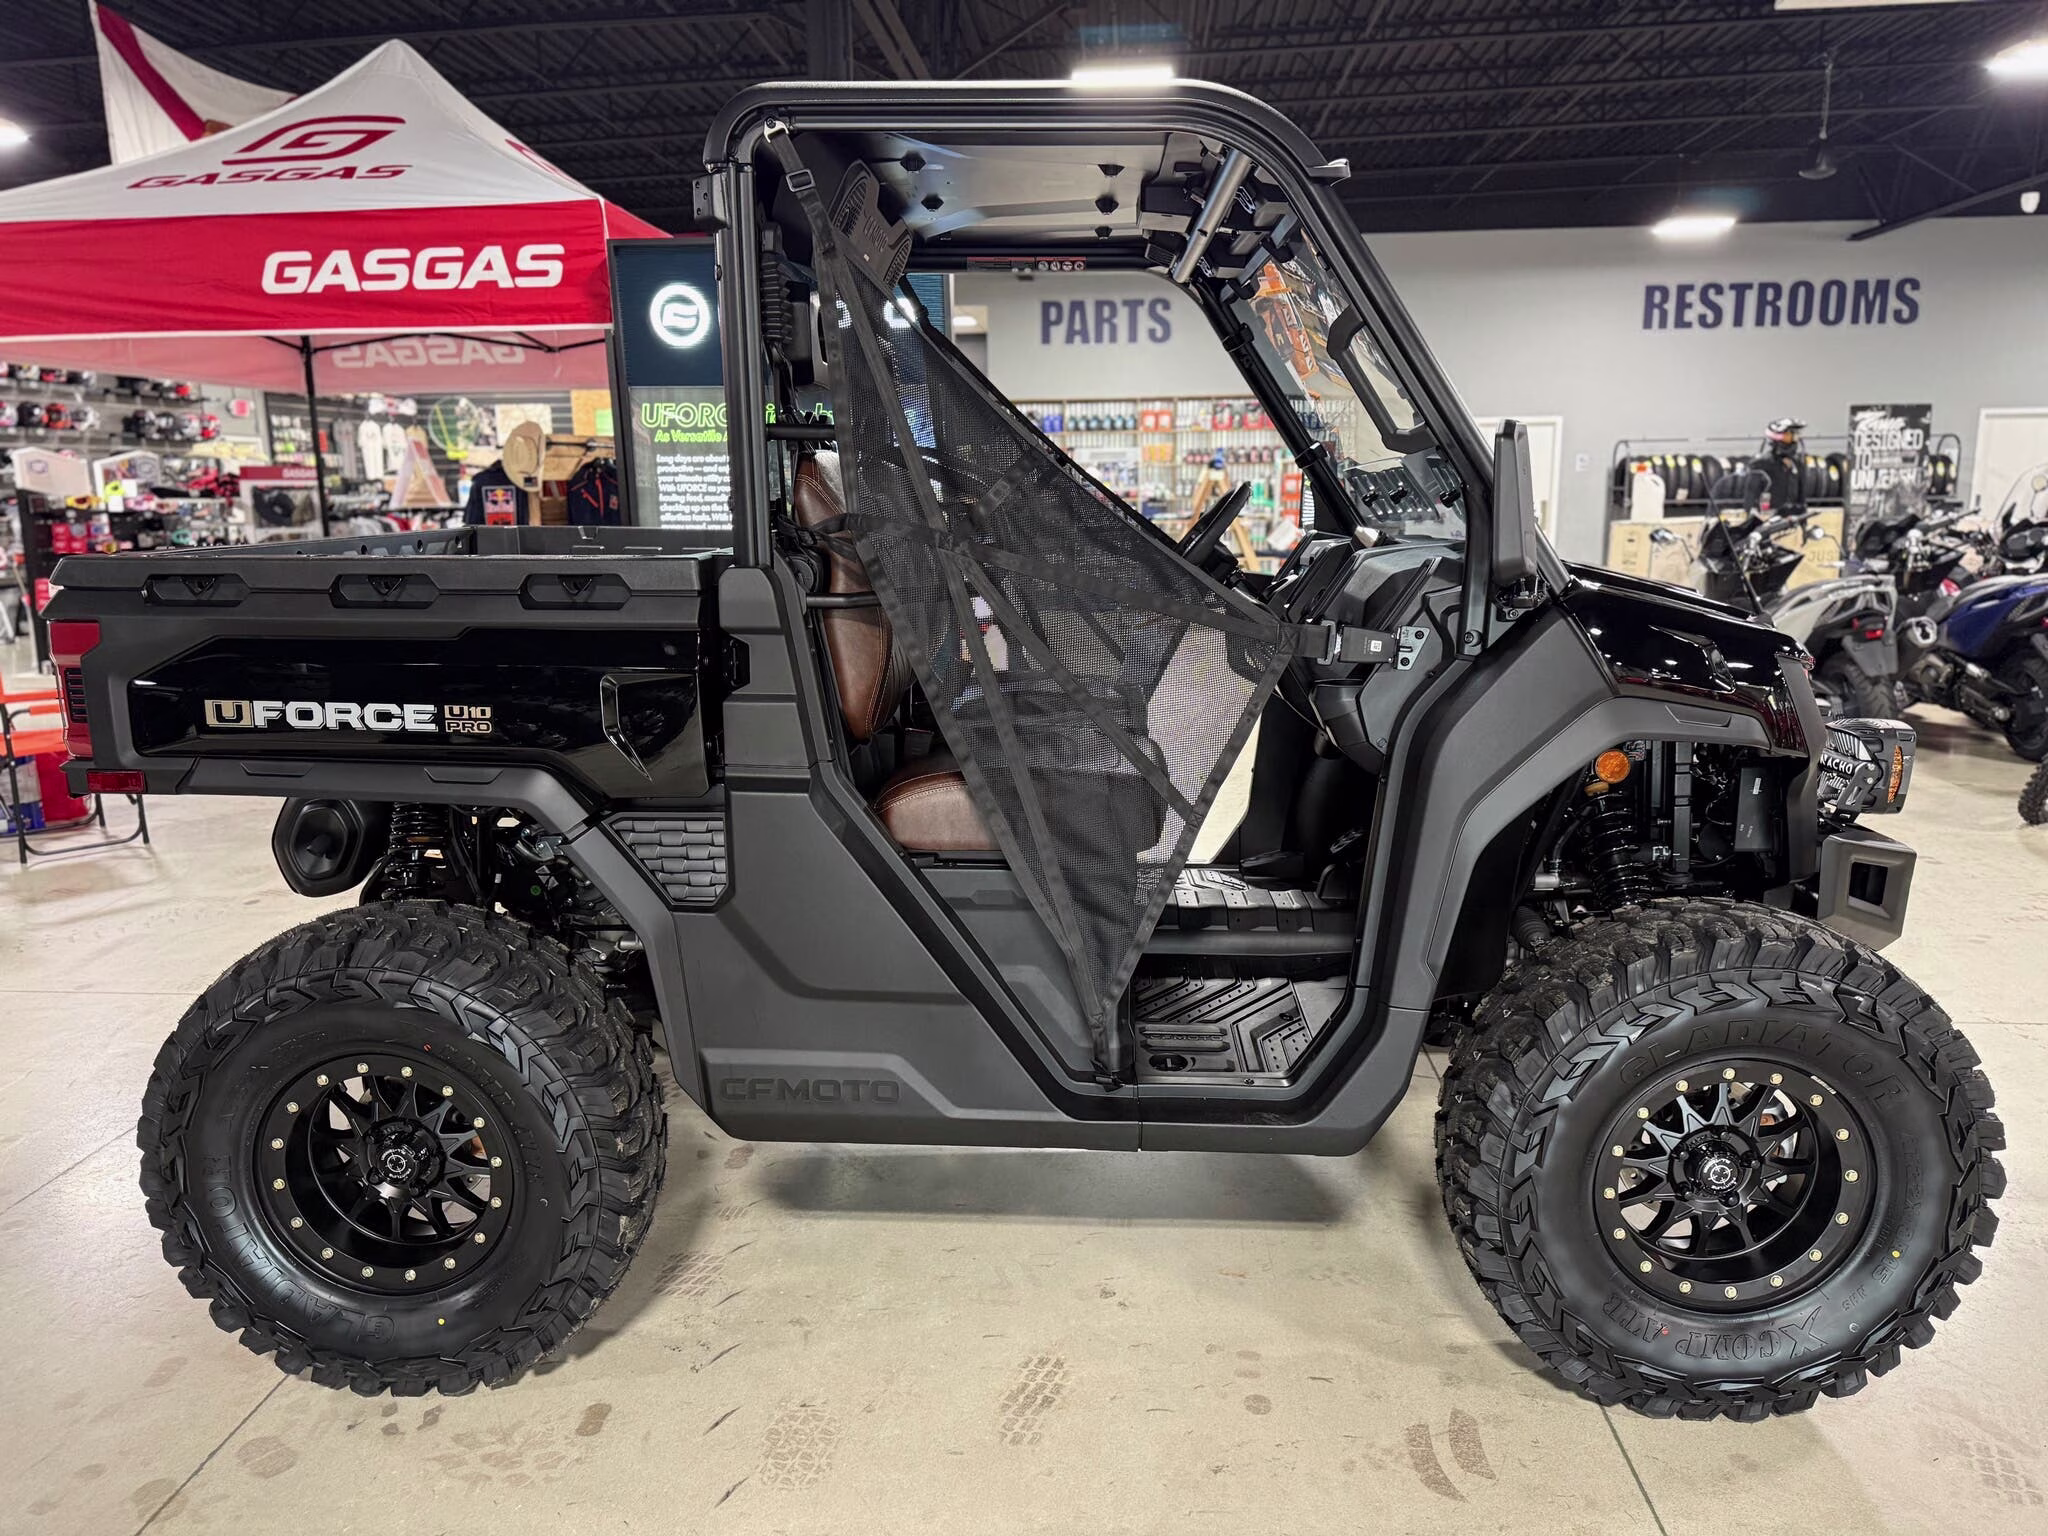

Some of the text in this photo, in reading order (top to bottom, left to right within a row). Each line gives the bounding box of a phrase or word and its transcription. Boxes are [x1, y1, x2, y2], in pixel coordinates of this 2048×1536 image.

[127, 164, 412, 190] GASGAS
[261, 244, 566, 295] GASGAS
[1642, 277, 1921, 330] RESTROOMS
[1041, 298, 1172, 345] PARTS
[641, 402, 728, 428] UFORC
[654, 429, 670, 443] As
[670, 429, 722, 443] Versatile
[1854, 429, 1924, 451] DESIGNED
[676, 484, 708, 492] UFORCE
[204, 699, 492, 732] UFORCE U10
[445, 719, 493, 733] PRO
[1820, 753, 1854, 775] NACHO
[1618, 1019, 1911, 1108] GLADIATOR
[719, 1077, 900, 1104] CFMOTO
[203, 1154, 396, 1345] GLADIATOR
